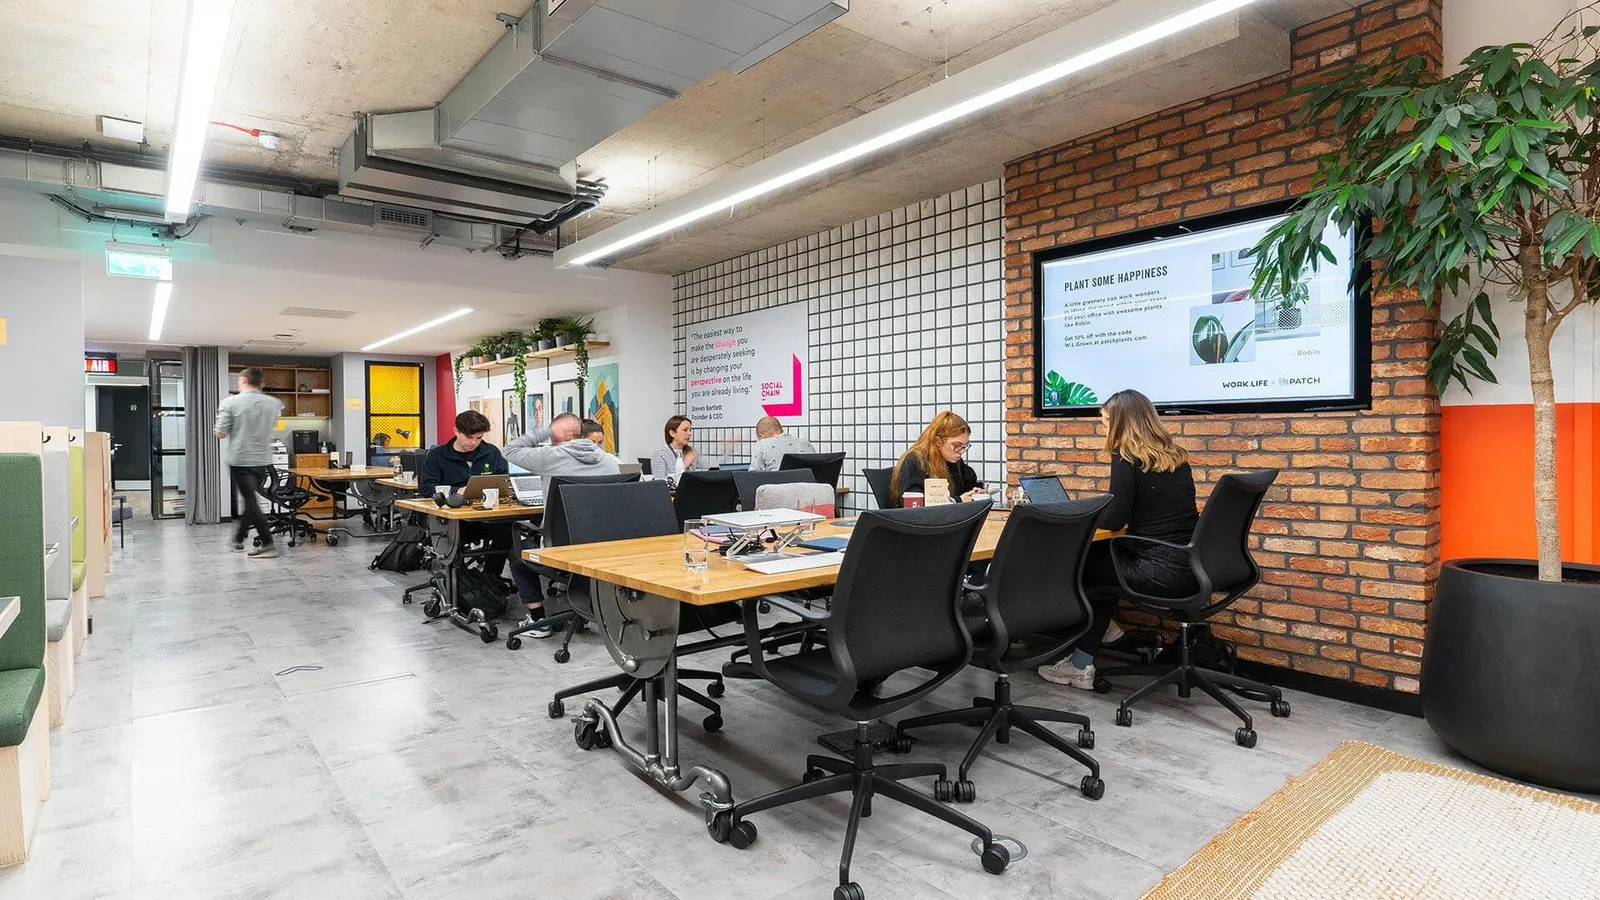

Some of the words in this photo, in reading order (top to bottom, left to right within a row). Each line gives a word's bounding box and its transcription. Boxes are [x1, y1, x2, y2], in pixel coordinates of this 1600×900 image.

[1064, 279, 1089, 292] PLANT
[1091, 274, 1115, 288] SOME
[1118, 265, 1168, 283] HAPPINESS
[1082, 298, 1106, 306] greenery
[1135, 289, 1160, 298] wonders
[1117, 306, 1142, 314] awesome
[1144, 303, 1163, 312] plants
[703, 329, 722, 339] easiest
[723, 328, 735, 336] way
[1100, 334, 1148, 345] patchplants.com
[691, 343, 704, 352] make
[705, 342, 714, 350] the
[737, 337, 748, 346] you
[690, 356, 699, 364] are
[700, 351, 731, 362] desperately
[732, 347, 756, 358] seeking
[91, 359, 109, 371] AIR
[690, 367, 695, 375] is
[696, 366, 703, 376] by
[704, 363, 729, 374] changing
[730, 362, 743, 371] your
[691, 377, 722, 387] perspective
[722, 376, 731, 384] on
[731, 373, 741, 382] the
[742, 372, 752, 381] life
[1290, 377, 1320, 385] PATCH
[691, 390, 701, 399] you
[701, 389, 711, 397] are
[711, 387, 732, 397] already
